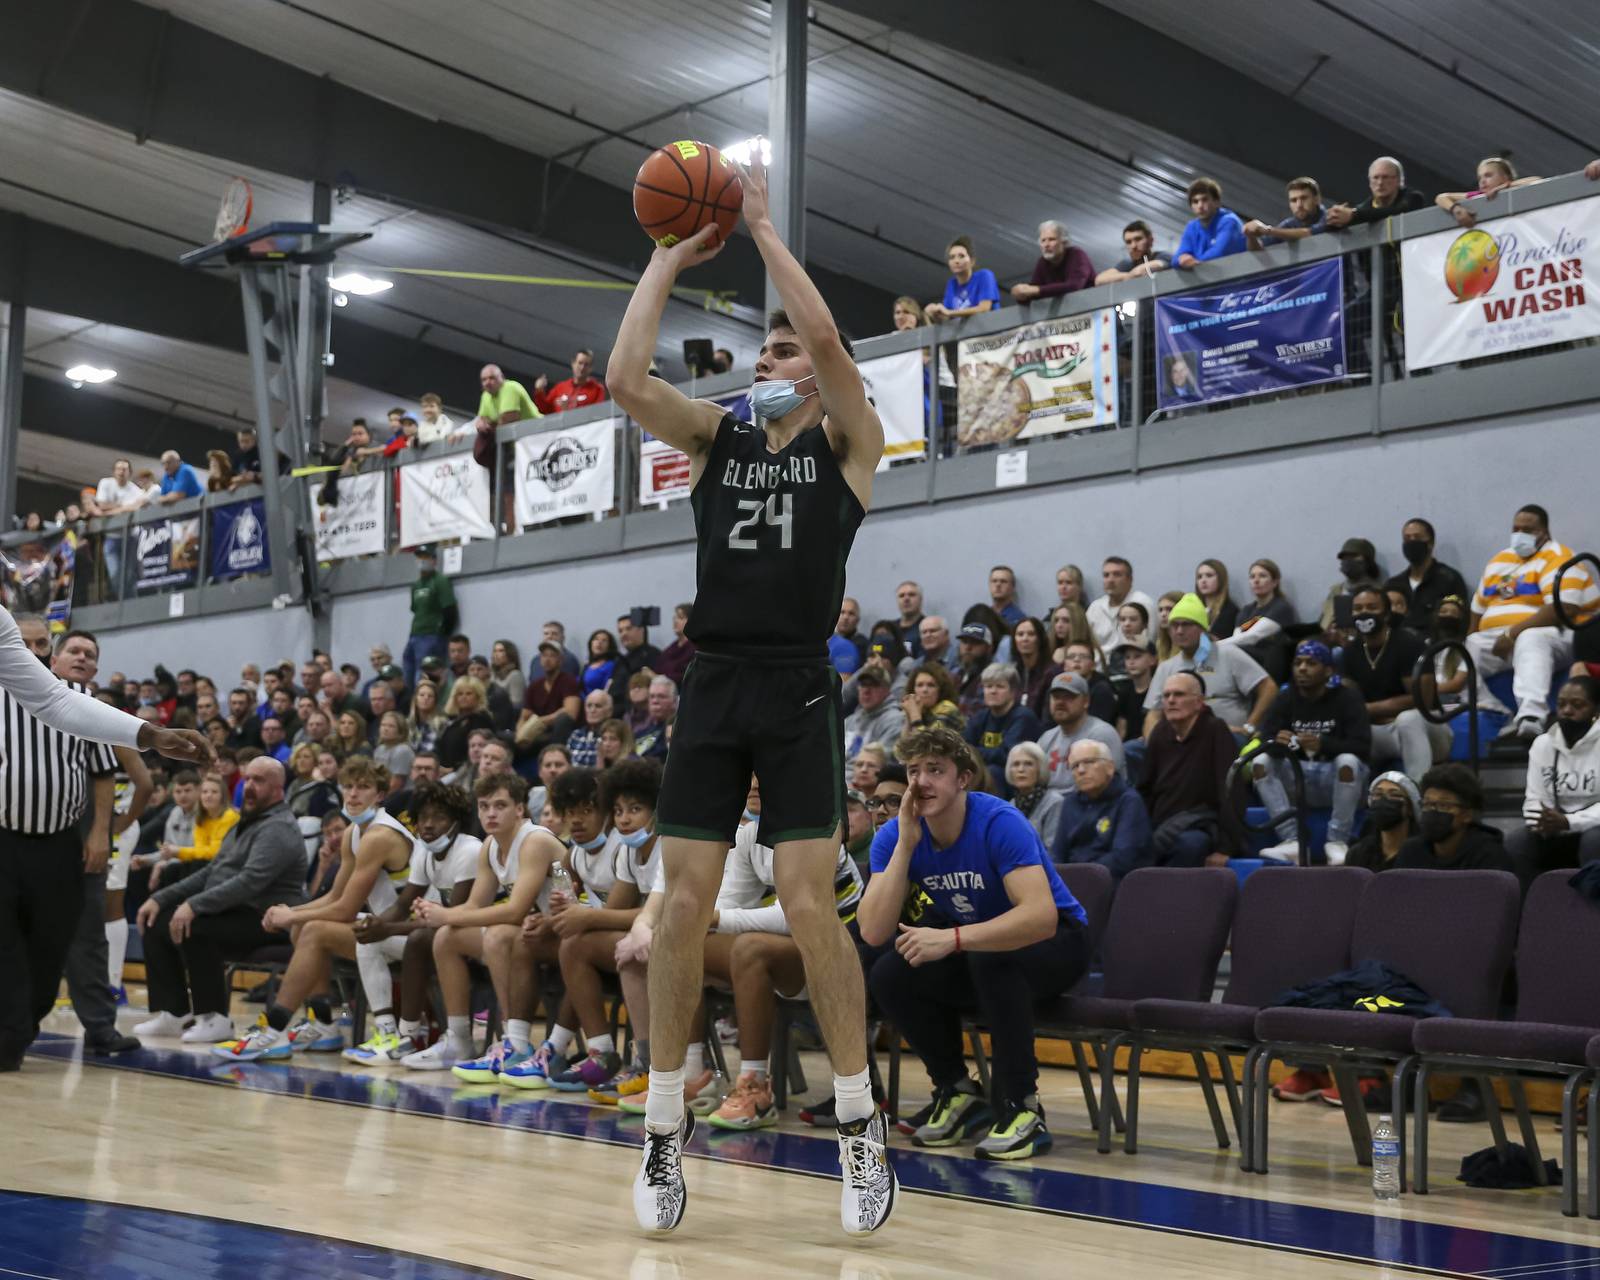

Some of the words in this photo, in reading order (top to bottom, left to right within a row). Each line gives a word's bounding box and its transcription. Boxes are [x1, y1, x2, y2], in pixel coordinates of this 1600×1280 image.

[1486, 227, 1587, 266] Paradise
[1514, 258, 1582, 290] CAR
[1483, 284, 1585, 323] WASH
[728, 493, 793, 550] 24
